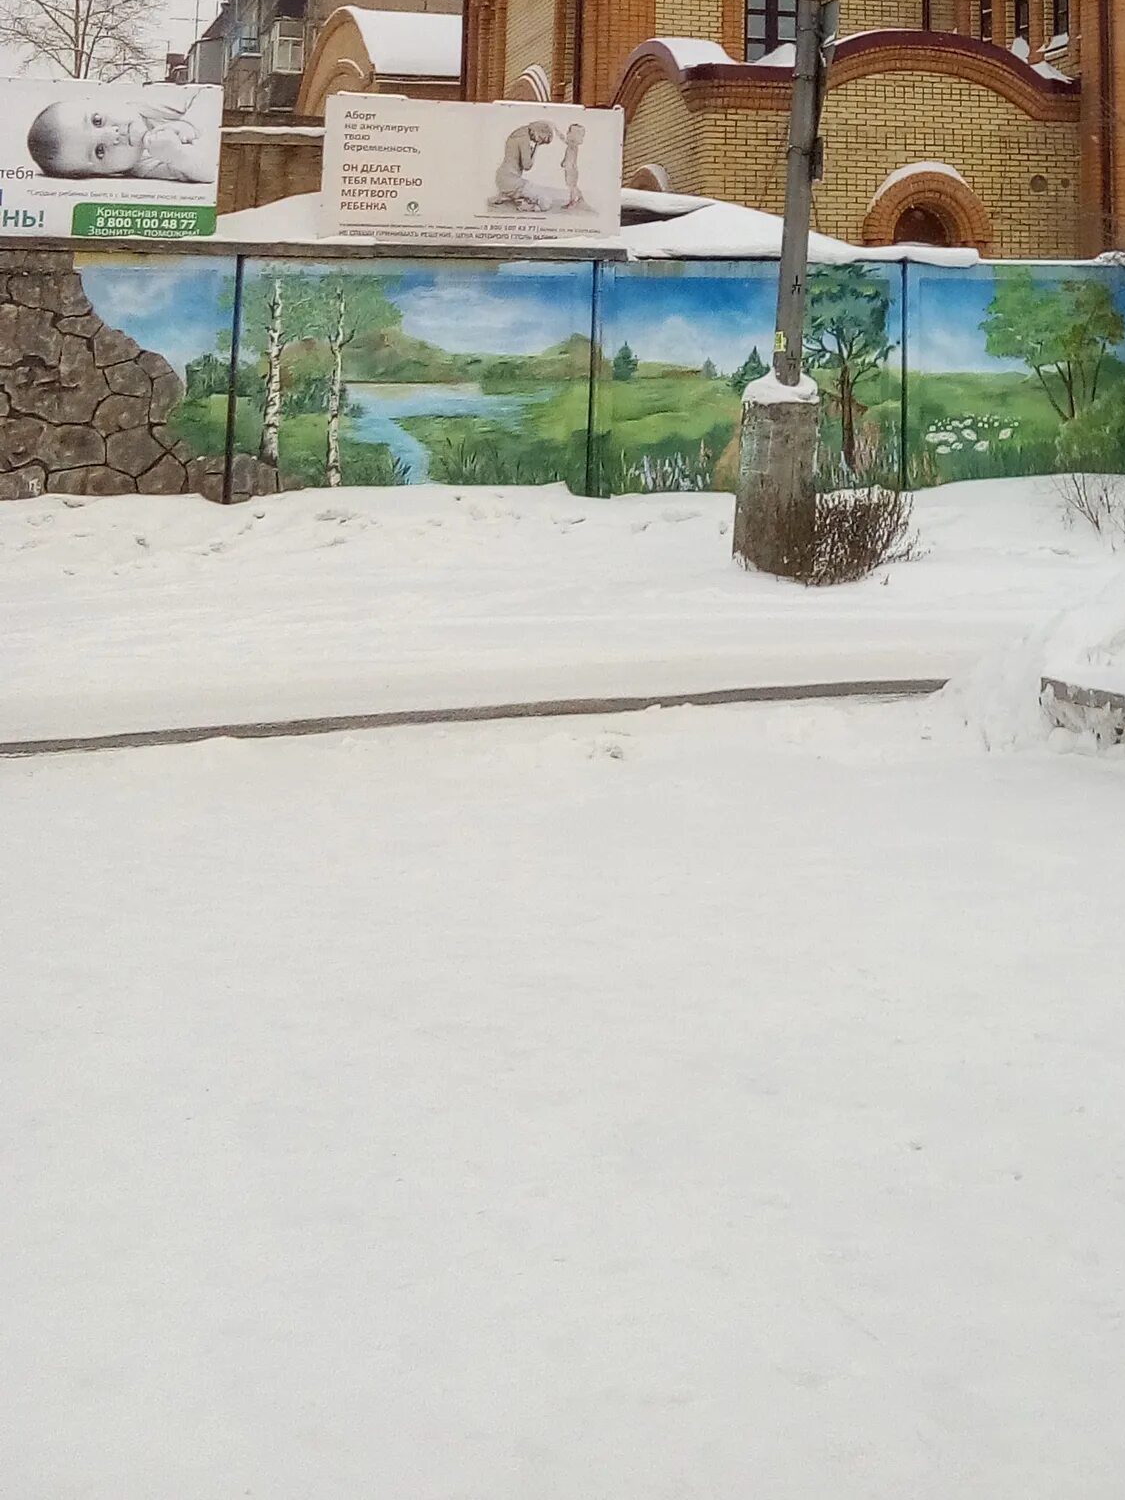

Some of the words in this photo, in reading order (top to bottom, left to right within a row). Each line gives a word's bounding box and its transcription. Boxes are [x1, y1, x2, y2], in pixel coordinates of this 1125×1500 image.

[344, 110, 377, 121] Аборт
[360, 124, 420, 133] аннулирует
[344, 133, 371, 141] твою
[343, 142, 421, 155] беременность,
[342, 163, 359, 172] ОН
[360, 164, 402, 174] ДЕЛАЕТ
[342, 176, 368, 185] ТЕБЯ
[370, 177, 423, 187] МАТЕРЬЮ
[341, 189, 398, 199] МЕРТВОГО
[340, 201, 387, 211] РЕБЕНКА
[96, 207, 157, 219] Кризисная
[160, 210, 198, 220] линия:
[96, 217, 105, 227] 8
[107, 218, 131, 228] 800
[135, 218, 159, 229] 100
[161, 219, 177, 229] 48
[180, 220, 197, 230] 77
